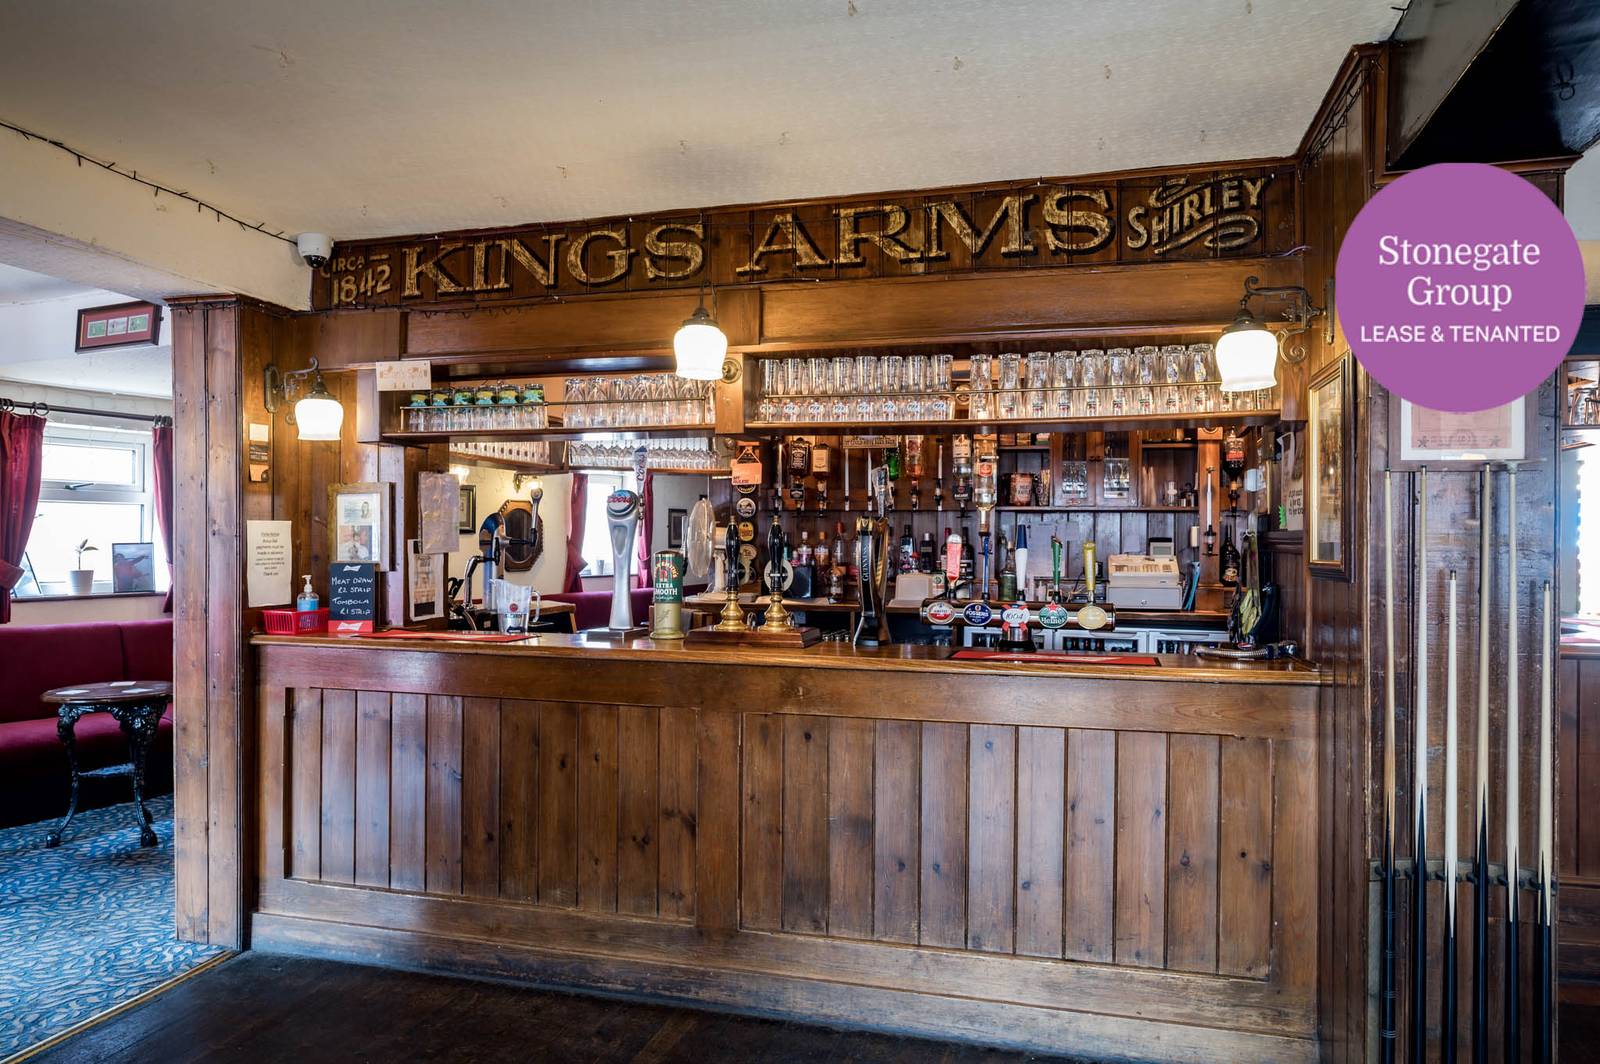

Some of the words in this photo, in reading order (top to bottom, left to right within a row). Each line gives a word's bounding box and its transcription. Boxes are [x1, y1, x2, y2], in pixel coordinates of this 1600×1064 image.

[1127, 178, 1265, 248] SHIRLEY
[402, 222, 704, 297] KINGS
[735, 189, 1111, 274] ARMS
[333, 264, 392, 305] 1842
[331, 576, 351, 586] MEAT
[332, 596, 370, 605] TOMBOLA
